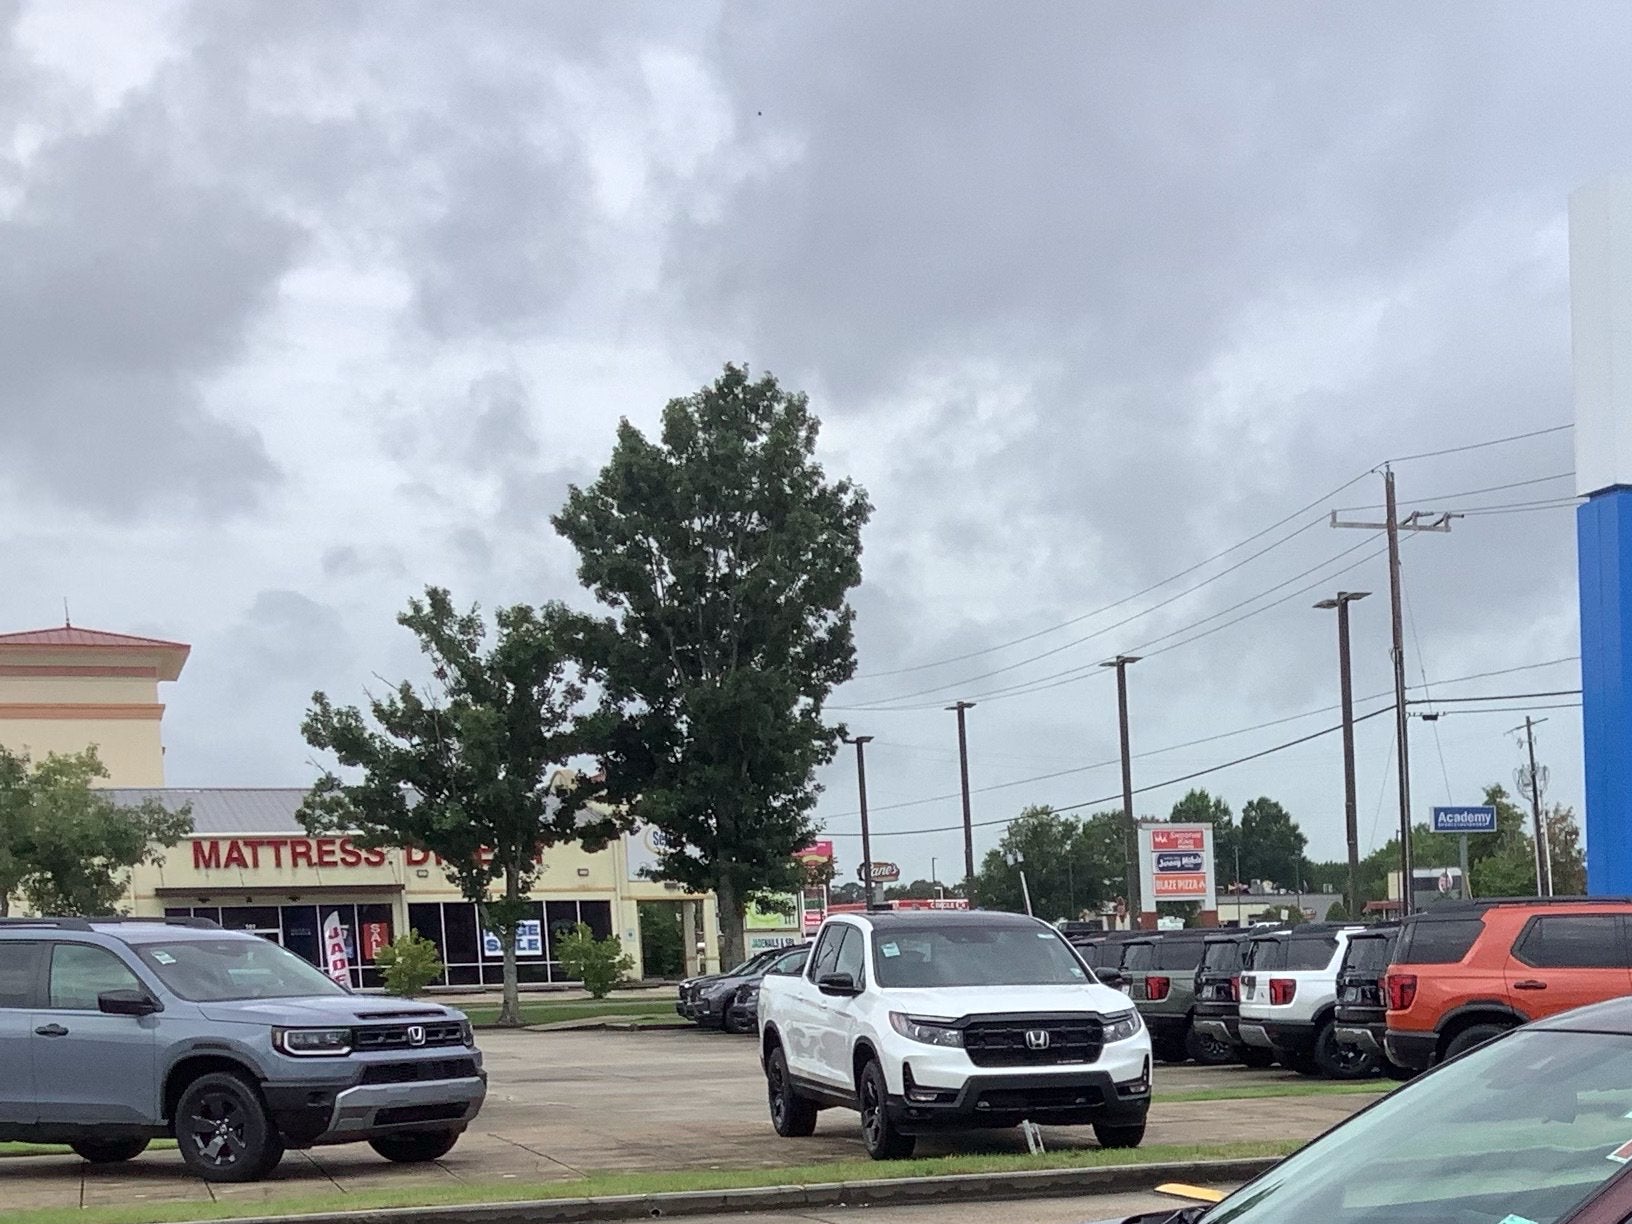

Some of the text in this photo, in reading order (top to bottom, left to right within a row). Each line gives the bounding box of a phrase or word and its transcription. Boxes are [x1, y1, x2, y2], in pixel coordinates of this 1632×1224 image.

[1438, 811, 1491, 826] Academy
[192, 839, 386, 869] MATTRESS
[486, 939, 539, 951] SLE
